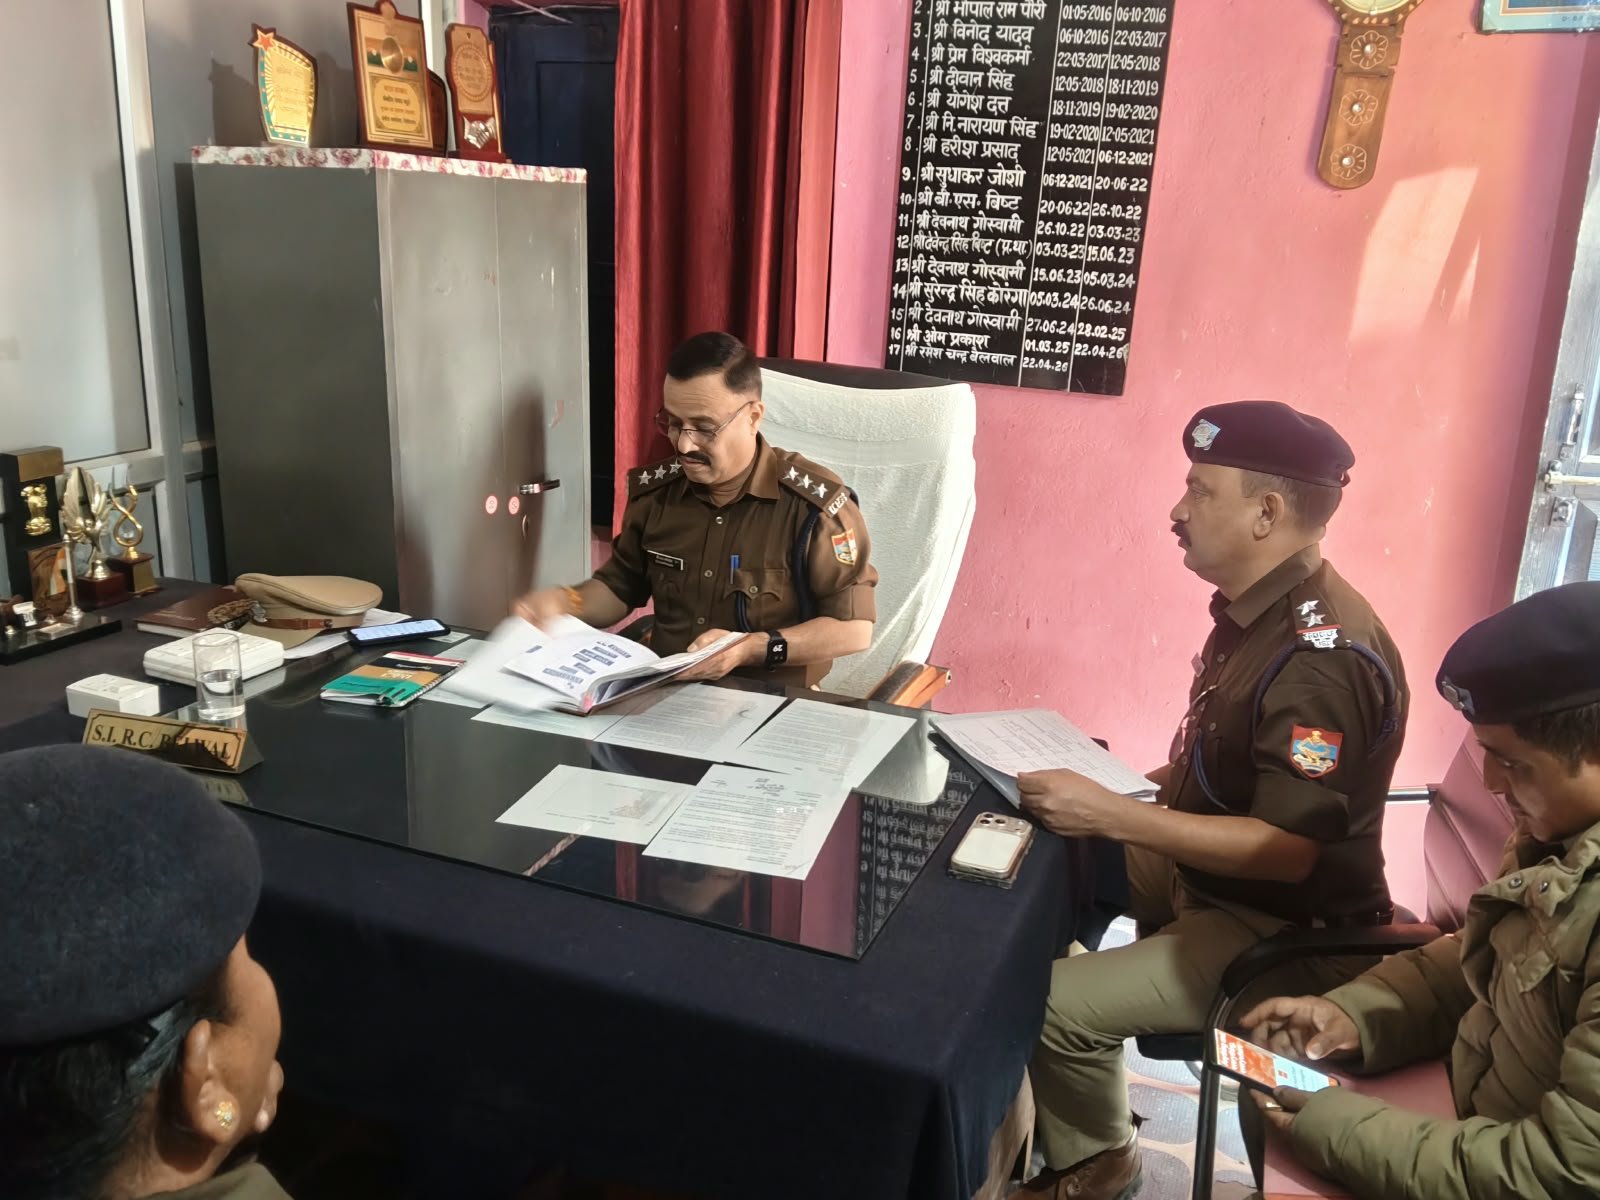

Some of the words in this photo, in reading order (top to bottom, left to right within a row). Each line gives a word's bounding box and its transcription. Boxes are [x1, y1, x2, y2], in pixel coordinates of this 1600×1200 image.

[996, 2, 1018, 18] राम
[934, 18, 948, 40] श्री
[952, 18, 992, 45] विनोद
[995, 25, 1035, 46] यादव
[931, 42, 945, 62] श्री
[948, 43, 968, 64] प्रेम
[972, 43, 1033, 66] विश्वकर्मा
[929, 65, 944, 85] श्री
[987, 67, 1015, 91] सिंह
[927, 88, 941, 108] श्री
[946, 89, 985, 114] योगेश
[987, 95, 1012, 115] दत्त
[926, 111, 939, 131] श्री
[1009, 116, 1039, 138] सिंह
[923, 133, 938, 153] श्री
[941, 135, 979, 159] हरीश
[981, 141, 1021, 163] प्रसाद
[920, 161, 935, 182] श्री
[935, 166, 985, 189] सुधाकर
[987, 162, 1026, 187] जोशी
[918, 185, 933, 206] श्री
[986, 189, 1022, 211] बिष्ट
[916, 209, 931, 229] श्री
[931, 209, 970, 231] देवनाथ
[972, 210, 1024, 234] गोस्वामी
[951, 231, 970, 254] सिंह
[912, 253, 927, 274] श्री
[928, 255, 970, 277] देवनाथ
[972, 258, 1026, 281] गोस्वामी
[908, 275, 923, 297] श्री
[923, 277, 958, 304] सुरेन्द्र
[958, 278, 987, 306] सिंह
[908, 300, 923, 320] श्री
[925, 302, 966, 327] देवनाथ
[967, 305, 1023, 331] गोस्वामी
[891, 327, 902, 340] 16
[906, 323, 922, 344] श्री
[923, 326, 948, 345] ओम
[949, 332, 991, 350] प्रकाश
[889, 343, 901, 356] 17
[905, 341, 918, 357] श्री
[919, 343, 944, 360] रमेश
[945, 348, 969, 364] चन्द्र
[92, 724, 116, 743] S.I.
[122, 729, 153, 749] R.C.
